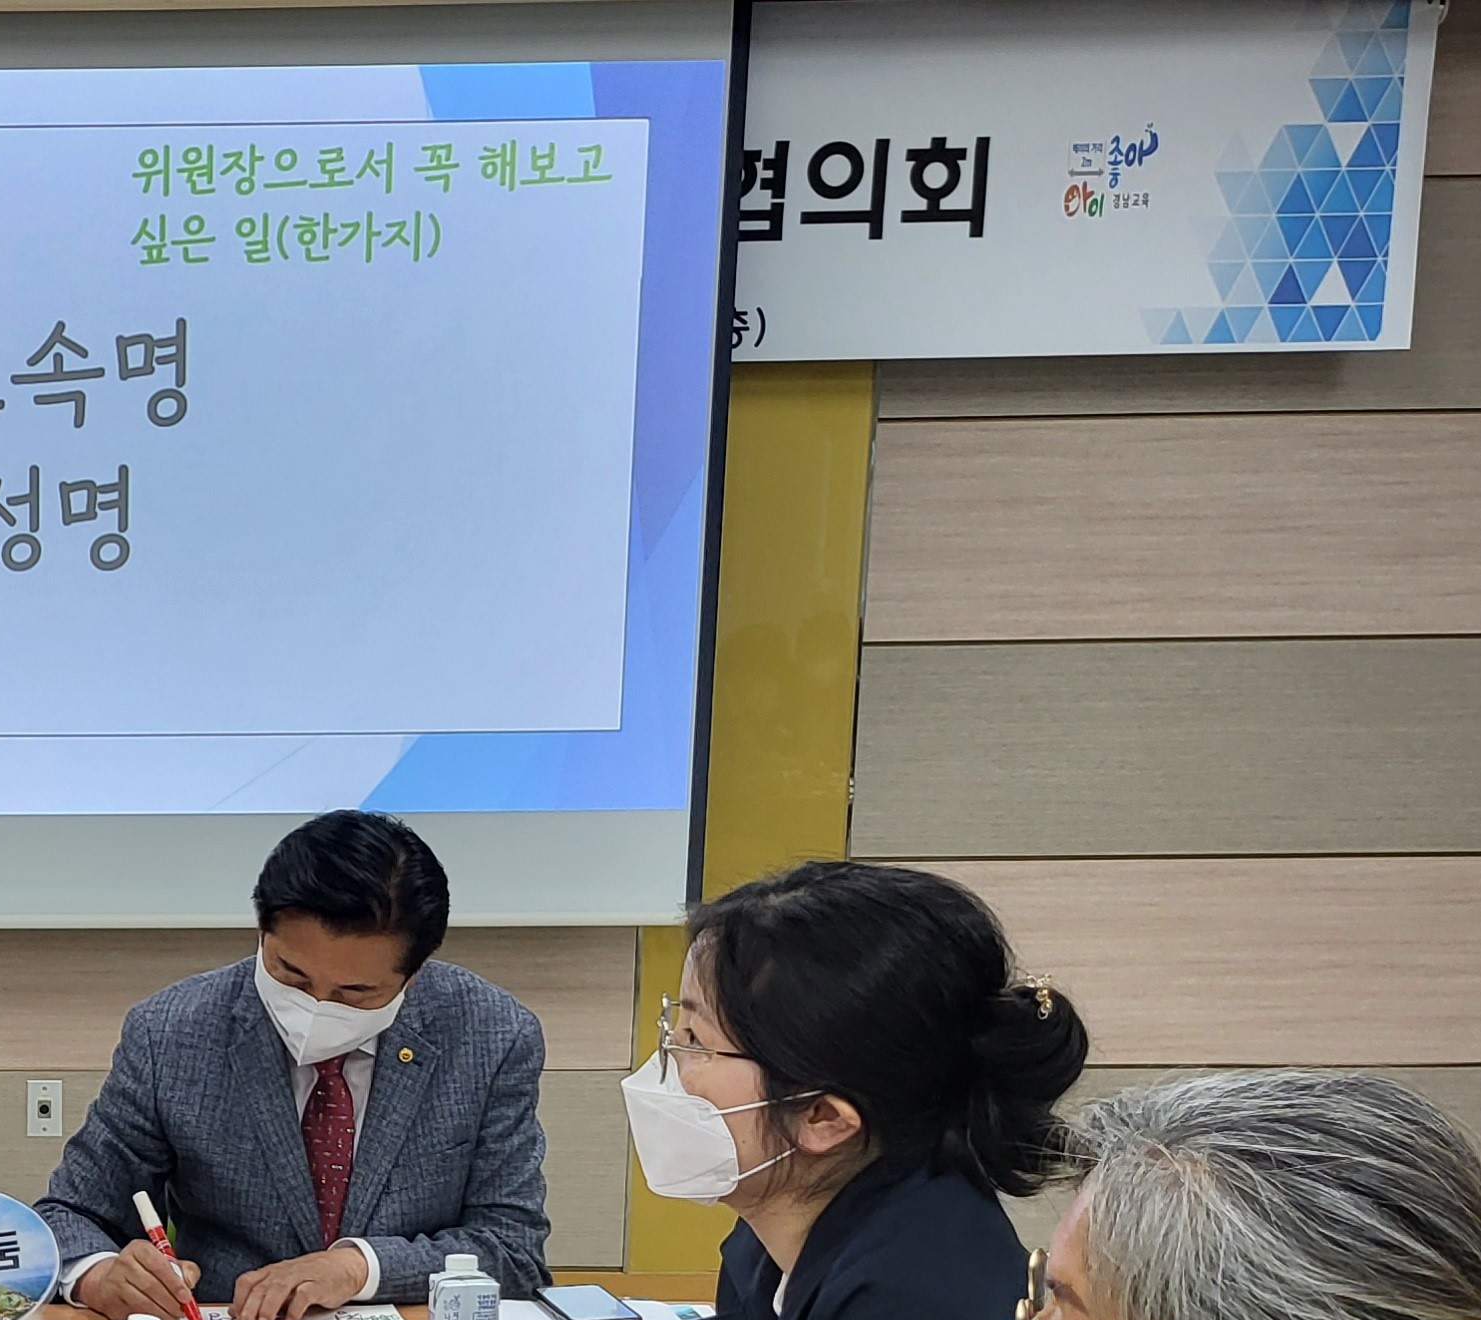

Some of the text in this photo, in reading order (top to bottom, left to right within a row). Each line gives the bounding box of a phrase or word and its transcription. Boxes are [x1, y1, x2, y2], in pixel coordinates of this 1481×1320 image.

[131, 140, 614, 197] 위원장으로서 꼭 해보고
[1113, 193, 1149, 209] 경남교육
[130, 210, 443, 267] 싶은 일(한가지)
